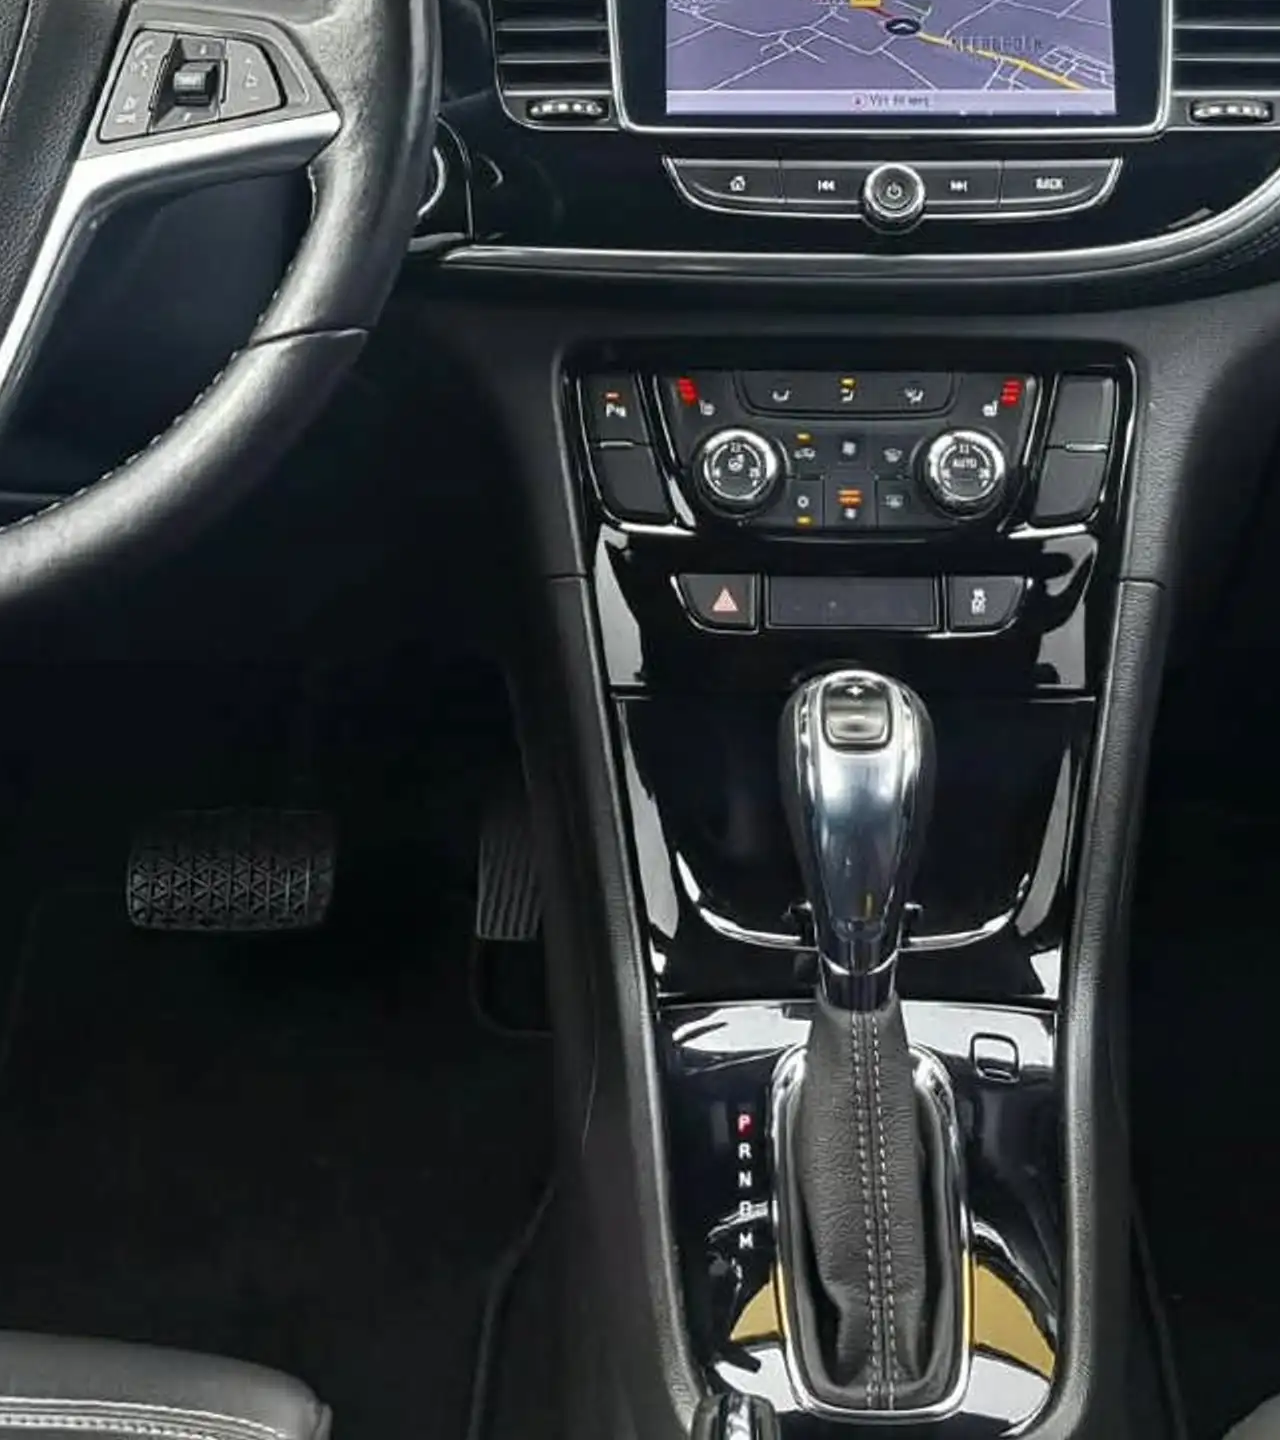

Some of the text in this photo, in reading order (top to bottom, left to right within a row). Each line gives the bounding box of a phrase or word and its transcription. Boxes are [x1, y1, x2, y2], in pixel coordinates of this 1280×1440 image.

[737, 1114, 751, 1133] P
[738, 1142, 752, 1159] R
[738, 1170, 753, 1188] N
[738, 1231, 754, 1249] M
